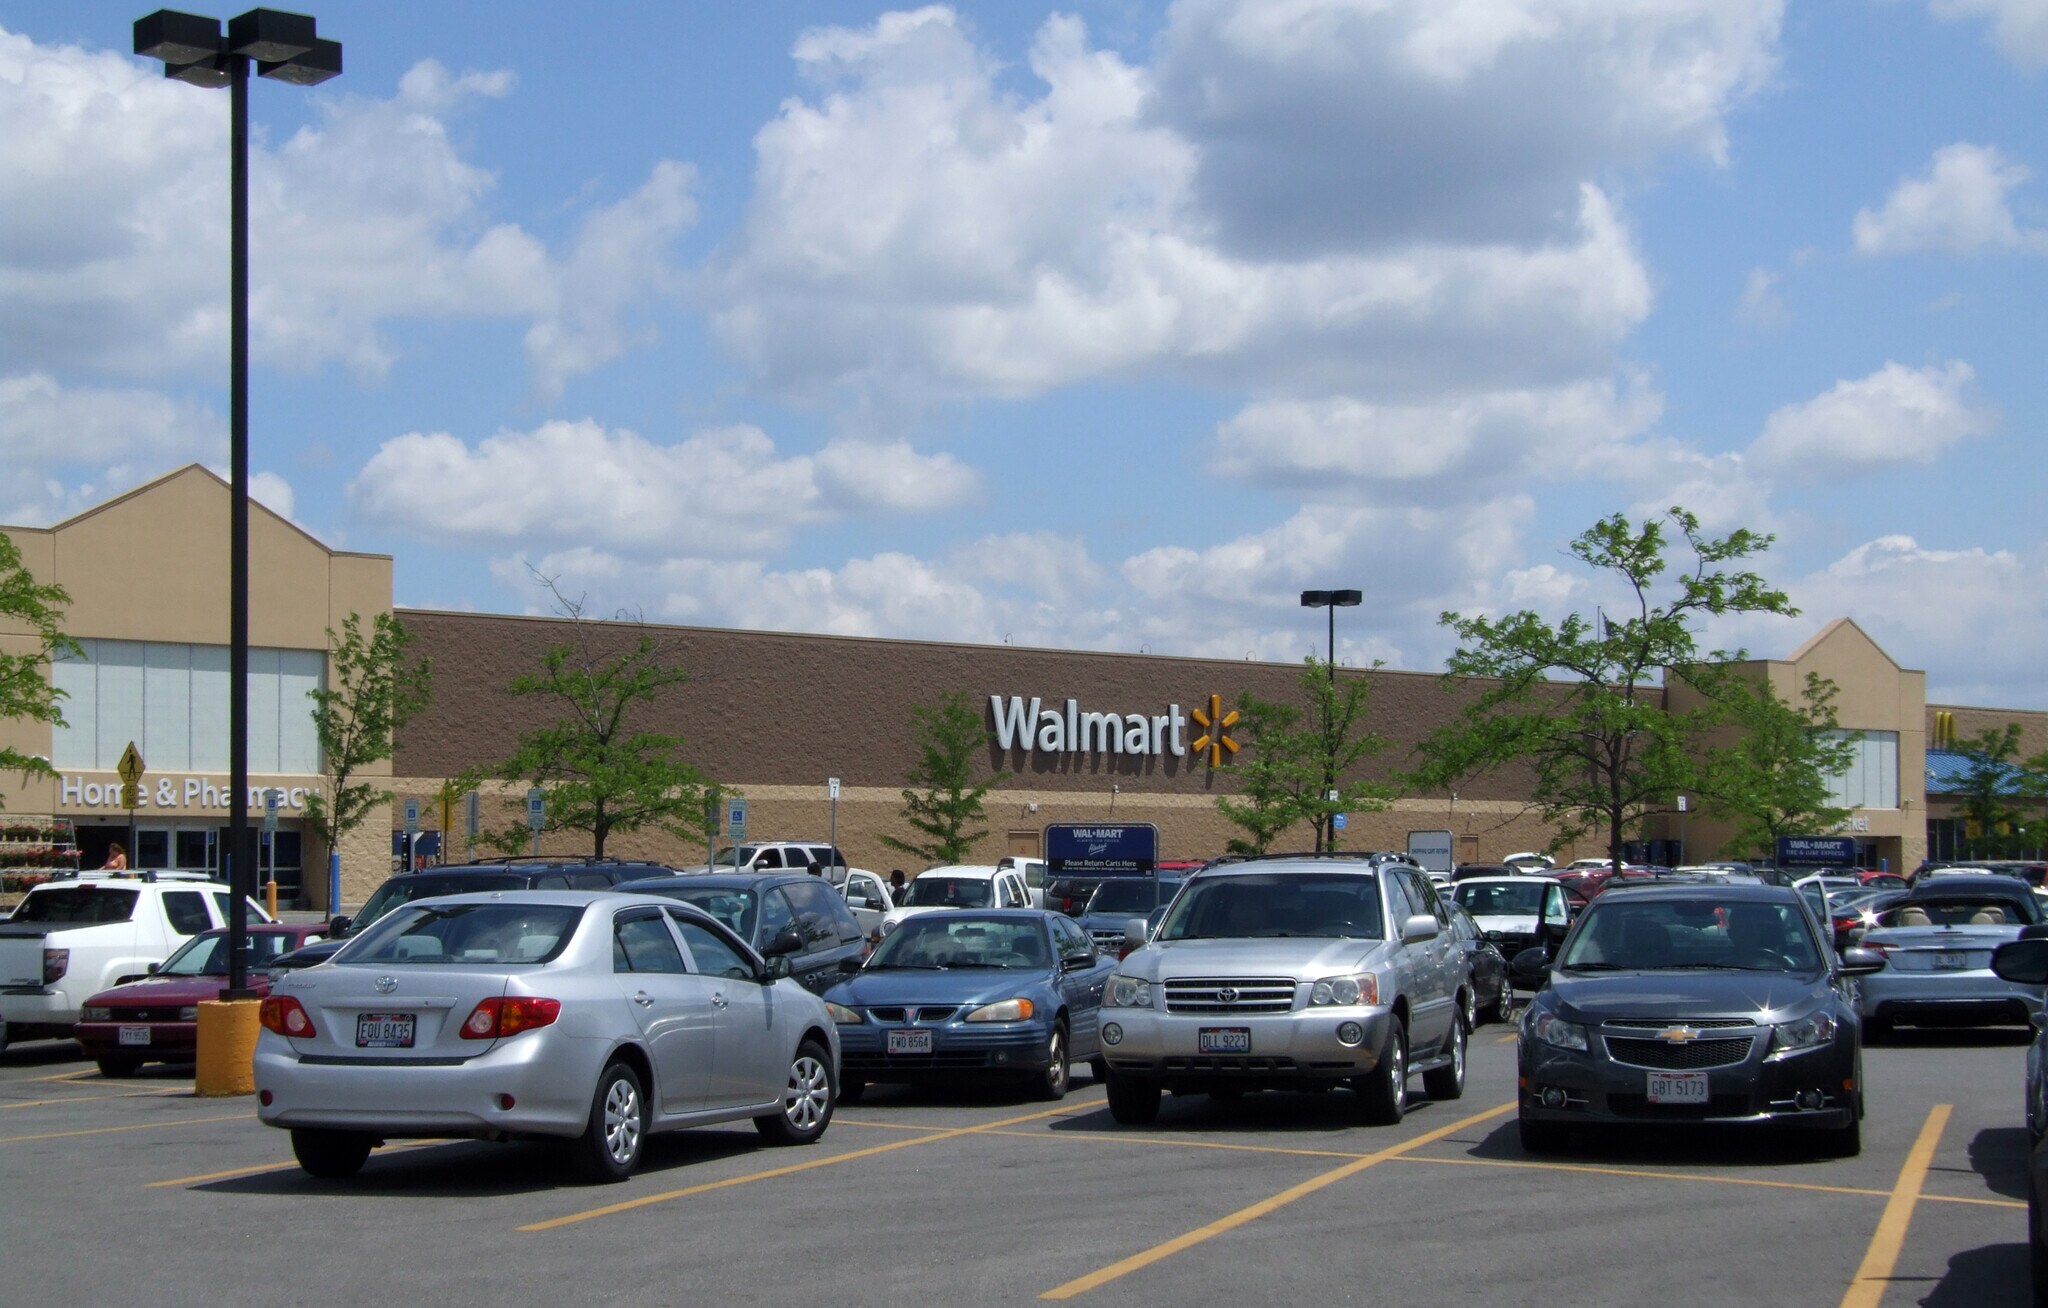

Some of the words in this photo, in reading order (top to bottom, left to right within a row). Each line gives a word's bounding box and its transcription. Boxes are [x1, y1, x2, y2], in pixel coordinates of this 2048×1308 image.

[990, 695, 1185, 756] Walmart
[61, 776, 149, 806] Home
[156, 778, 177, 806] &
[184, 778, 320, 808] Phamac
[384, 1023, 410, 1039] 8435
[908, 1036, 929, 1048] 8564
[1202, 1035, 1220, 1048] DLL
[1223, 1035, 1246, 1048] 9223
[1652, 1080, 1672, 1095] GBT
[1676, 1080, 1704, 1095] 5173
